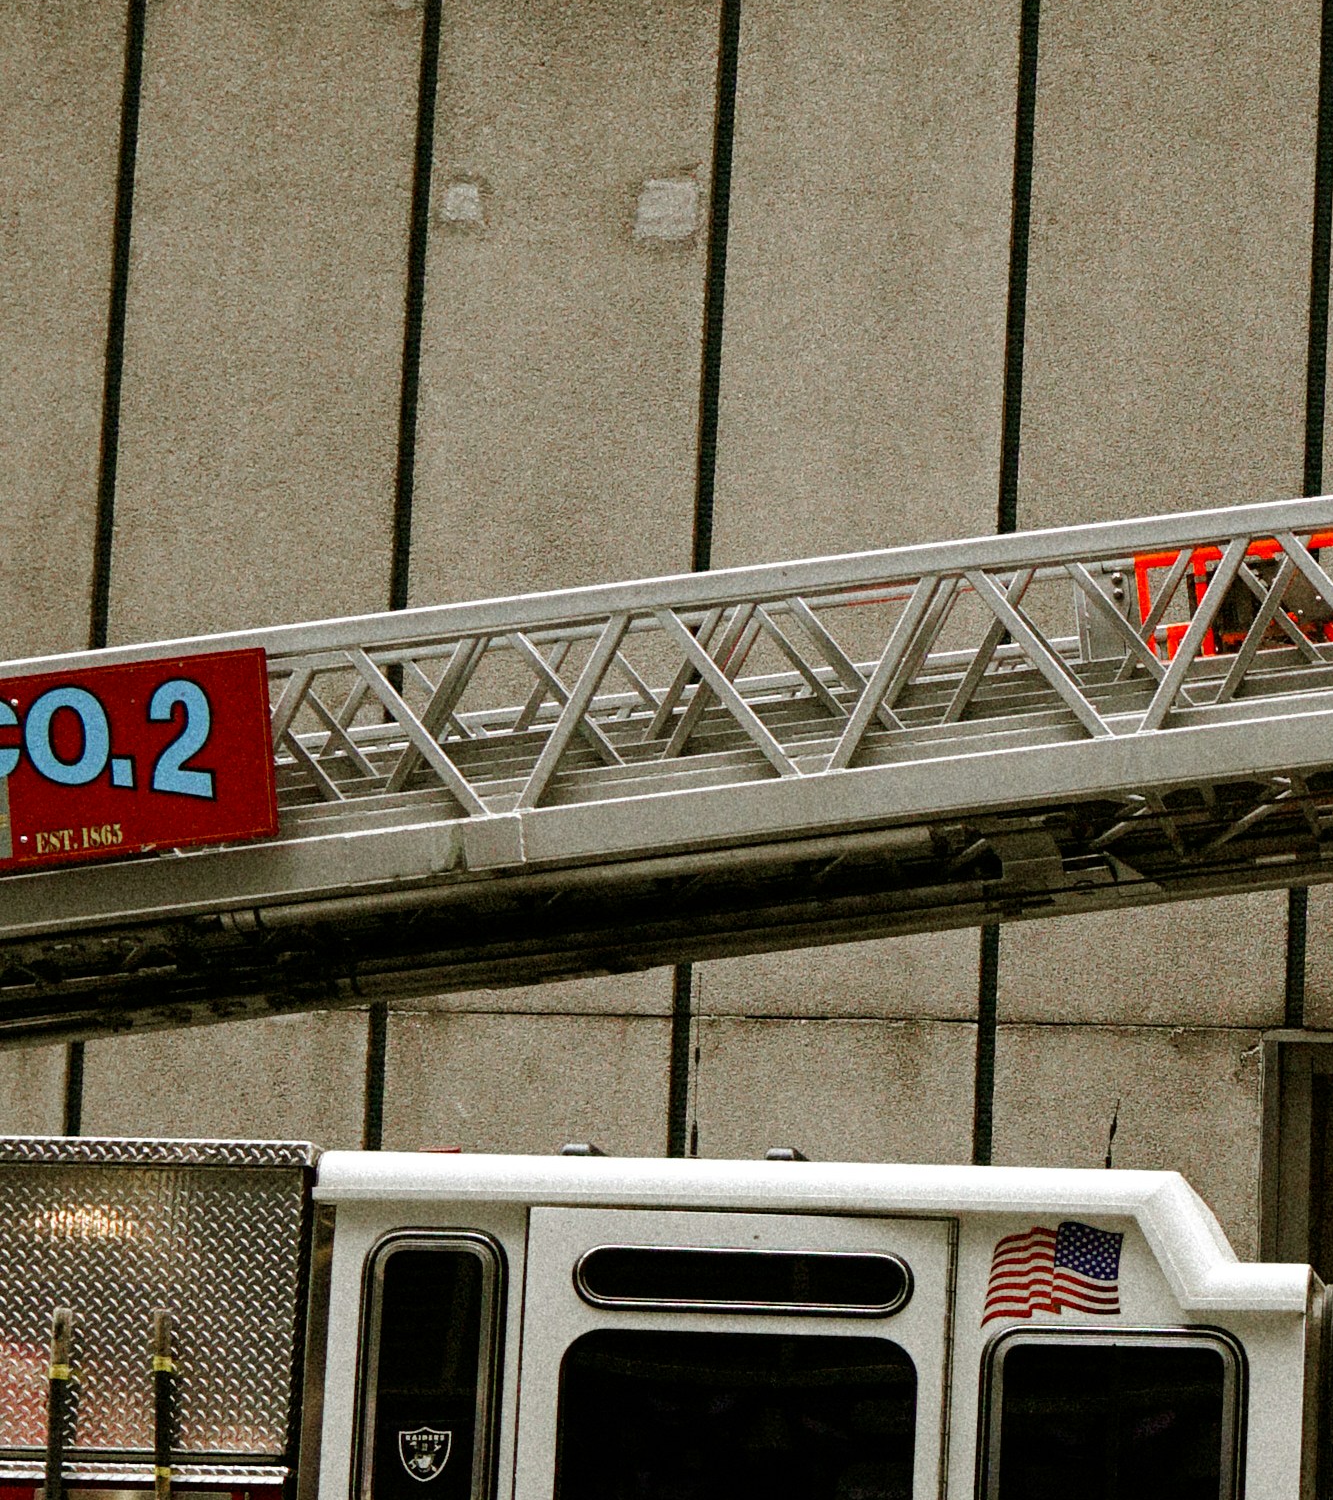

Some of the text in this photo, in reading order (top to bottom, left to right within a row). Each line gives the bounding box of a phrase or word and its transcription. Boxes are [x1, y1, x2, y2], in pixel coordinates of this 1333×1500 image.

[0, 679, 214, 799] O. 2
[35, 823, 124, 854] EST. 1865
